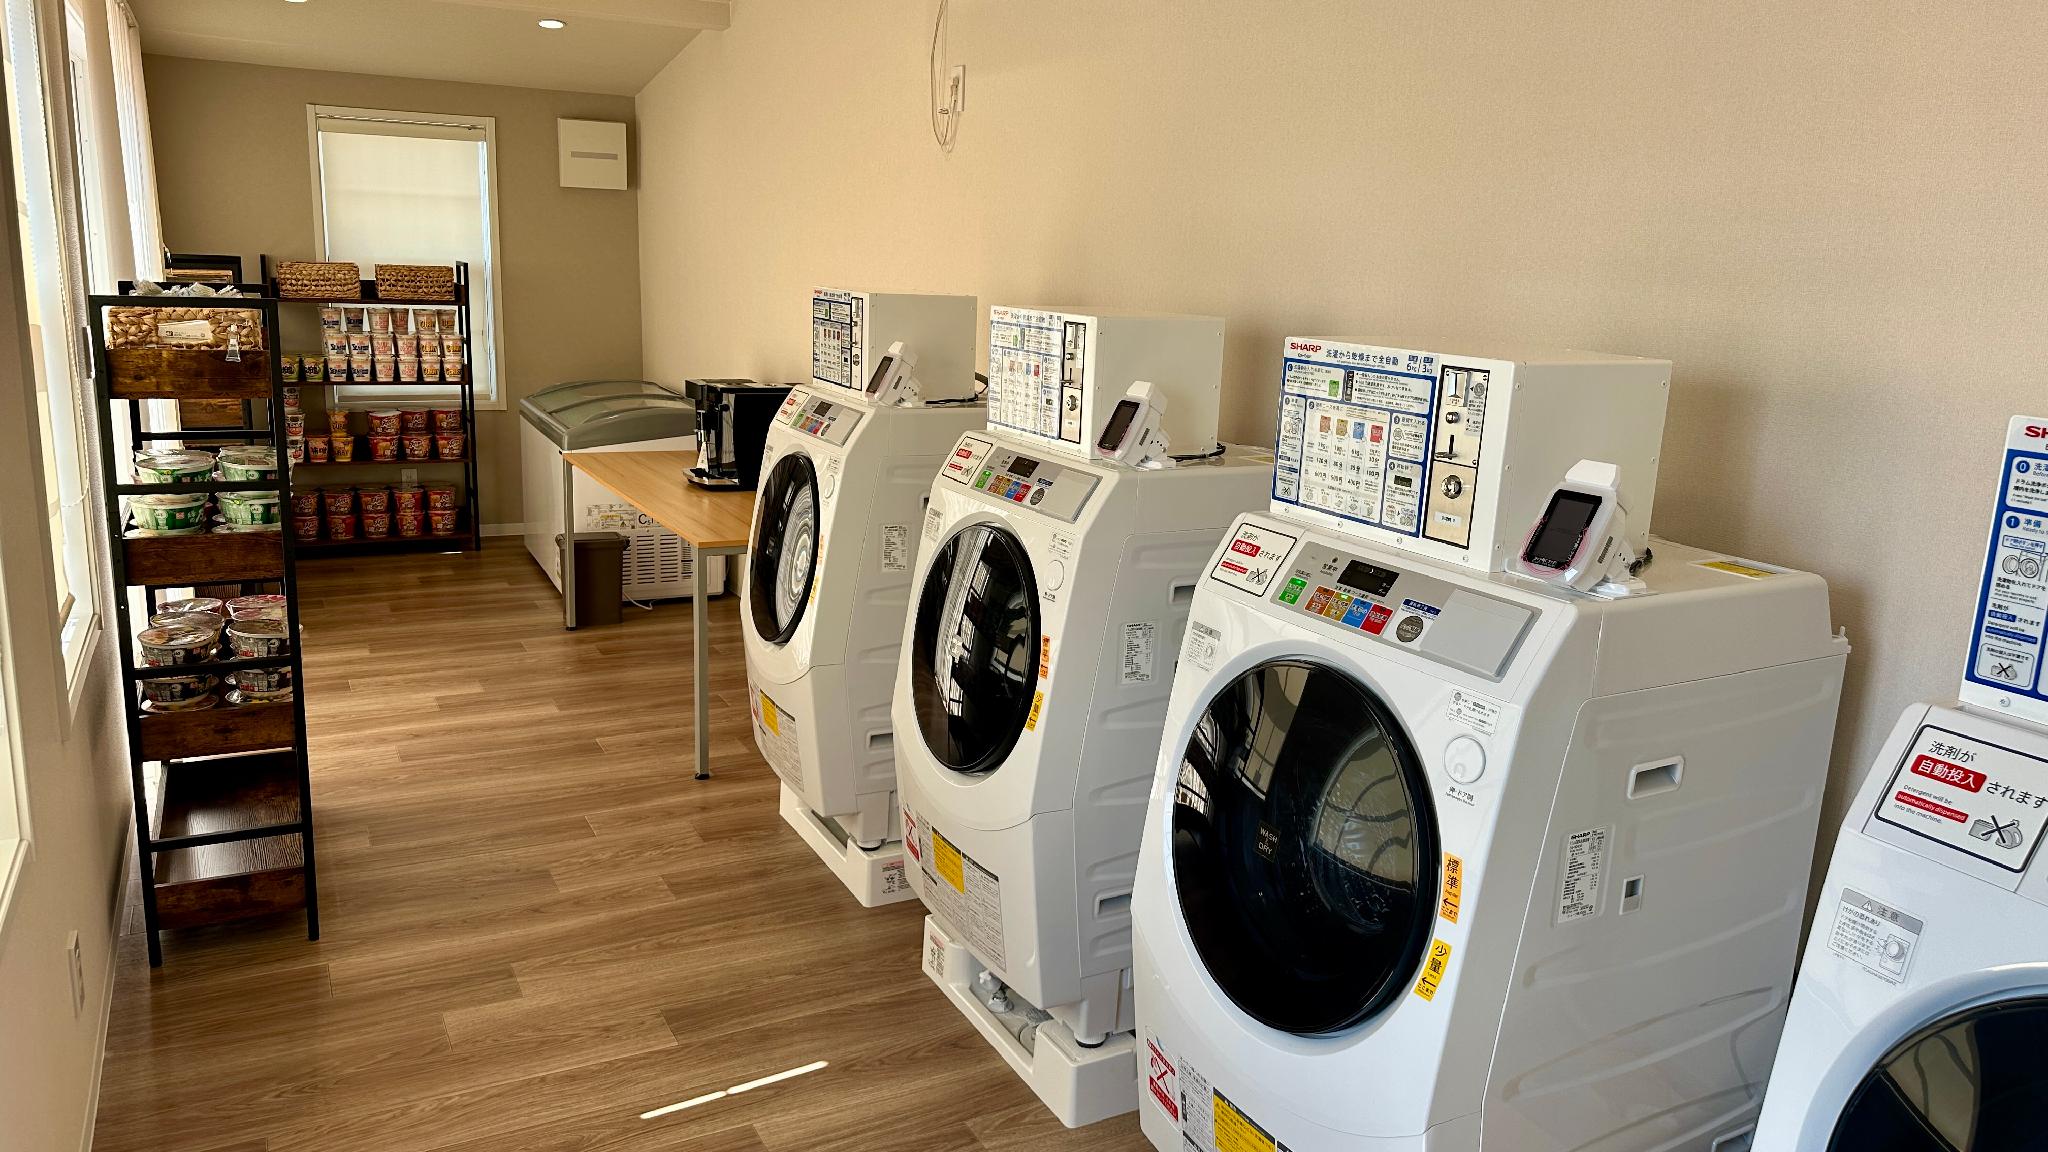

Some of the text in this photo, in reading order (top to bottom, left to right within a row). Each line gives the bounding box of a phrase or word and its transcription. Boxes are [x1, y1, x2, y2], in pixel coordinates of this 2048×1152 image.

[1290, 342, 1322, 353] SHARP
[1928, 740, 1977, 763] 洗剤が
[1917, 758, 1976, 789] 自動投入
[1903, 784, 1953, 806] Detergent will be
[1986, 781, 2048, 809] されます
[1894, 803, 1943, 824] into the machine.
[1897, 793, 1967, 821] automatically dispensed
[1260, 827, 1278, 843] WASH
[1258, 842, 1273, 854] DRY
[1446, 856, 1460, 890] 標準
[1441, 905, 1458, 918] ここまで
[1842, 905, 1881, 927] けがの恐れあり
[1877, 907, 1899, 922] 注意
[1428, 944, 1448, 975] 少量
[1417, 982, 1434, 996] ここまで
